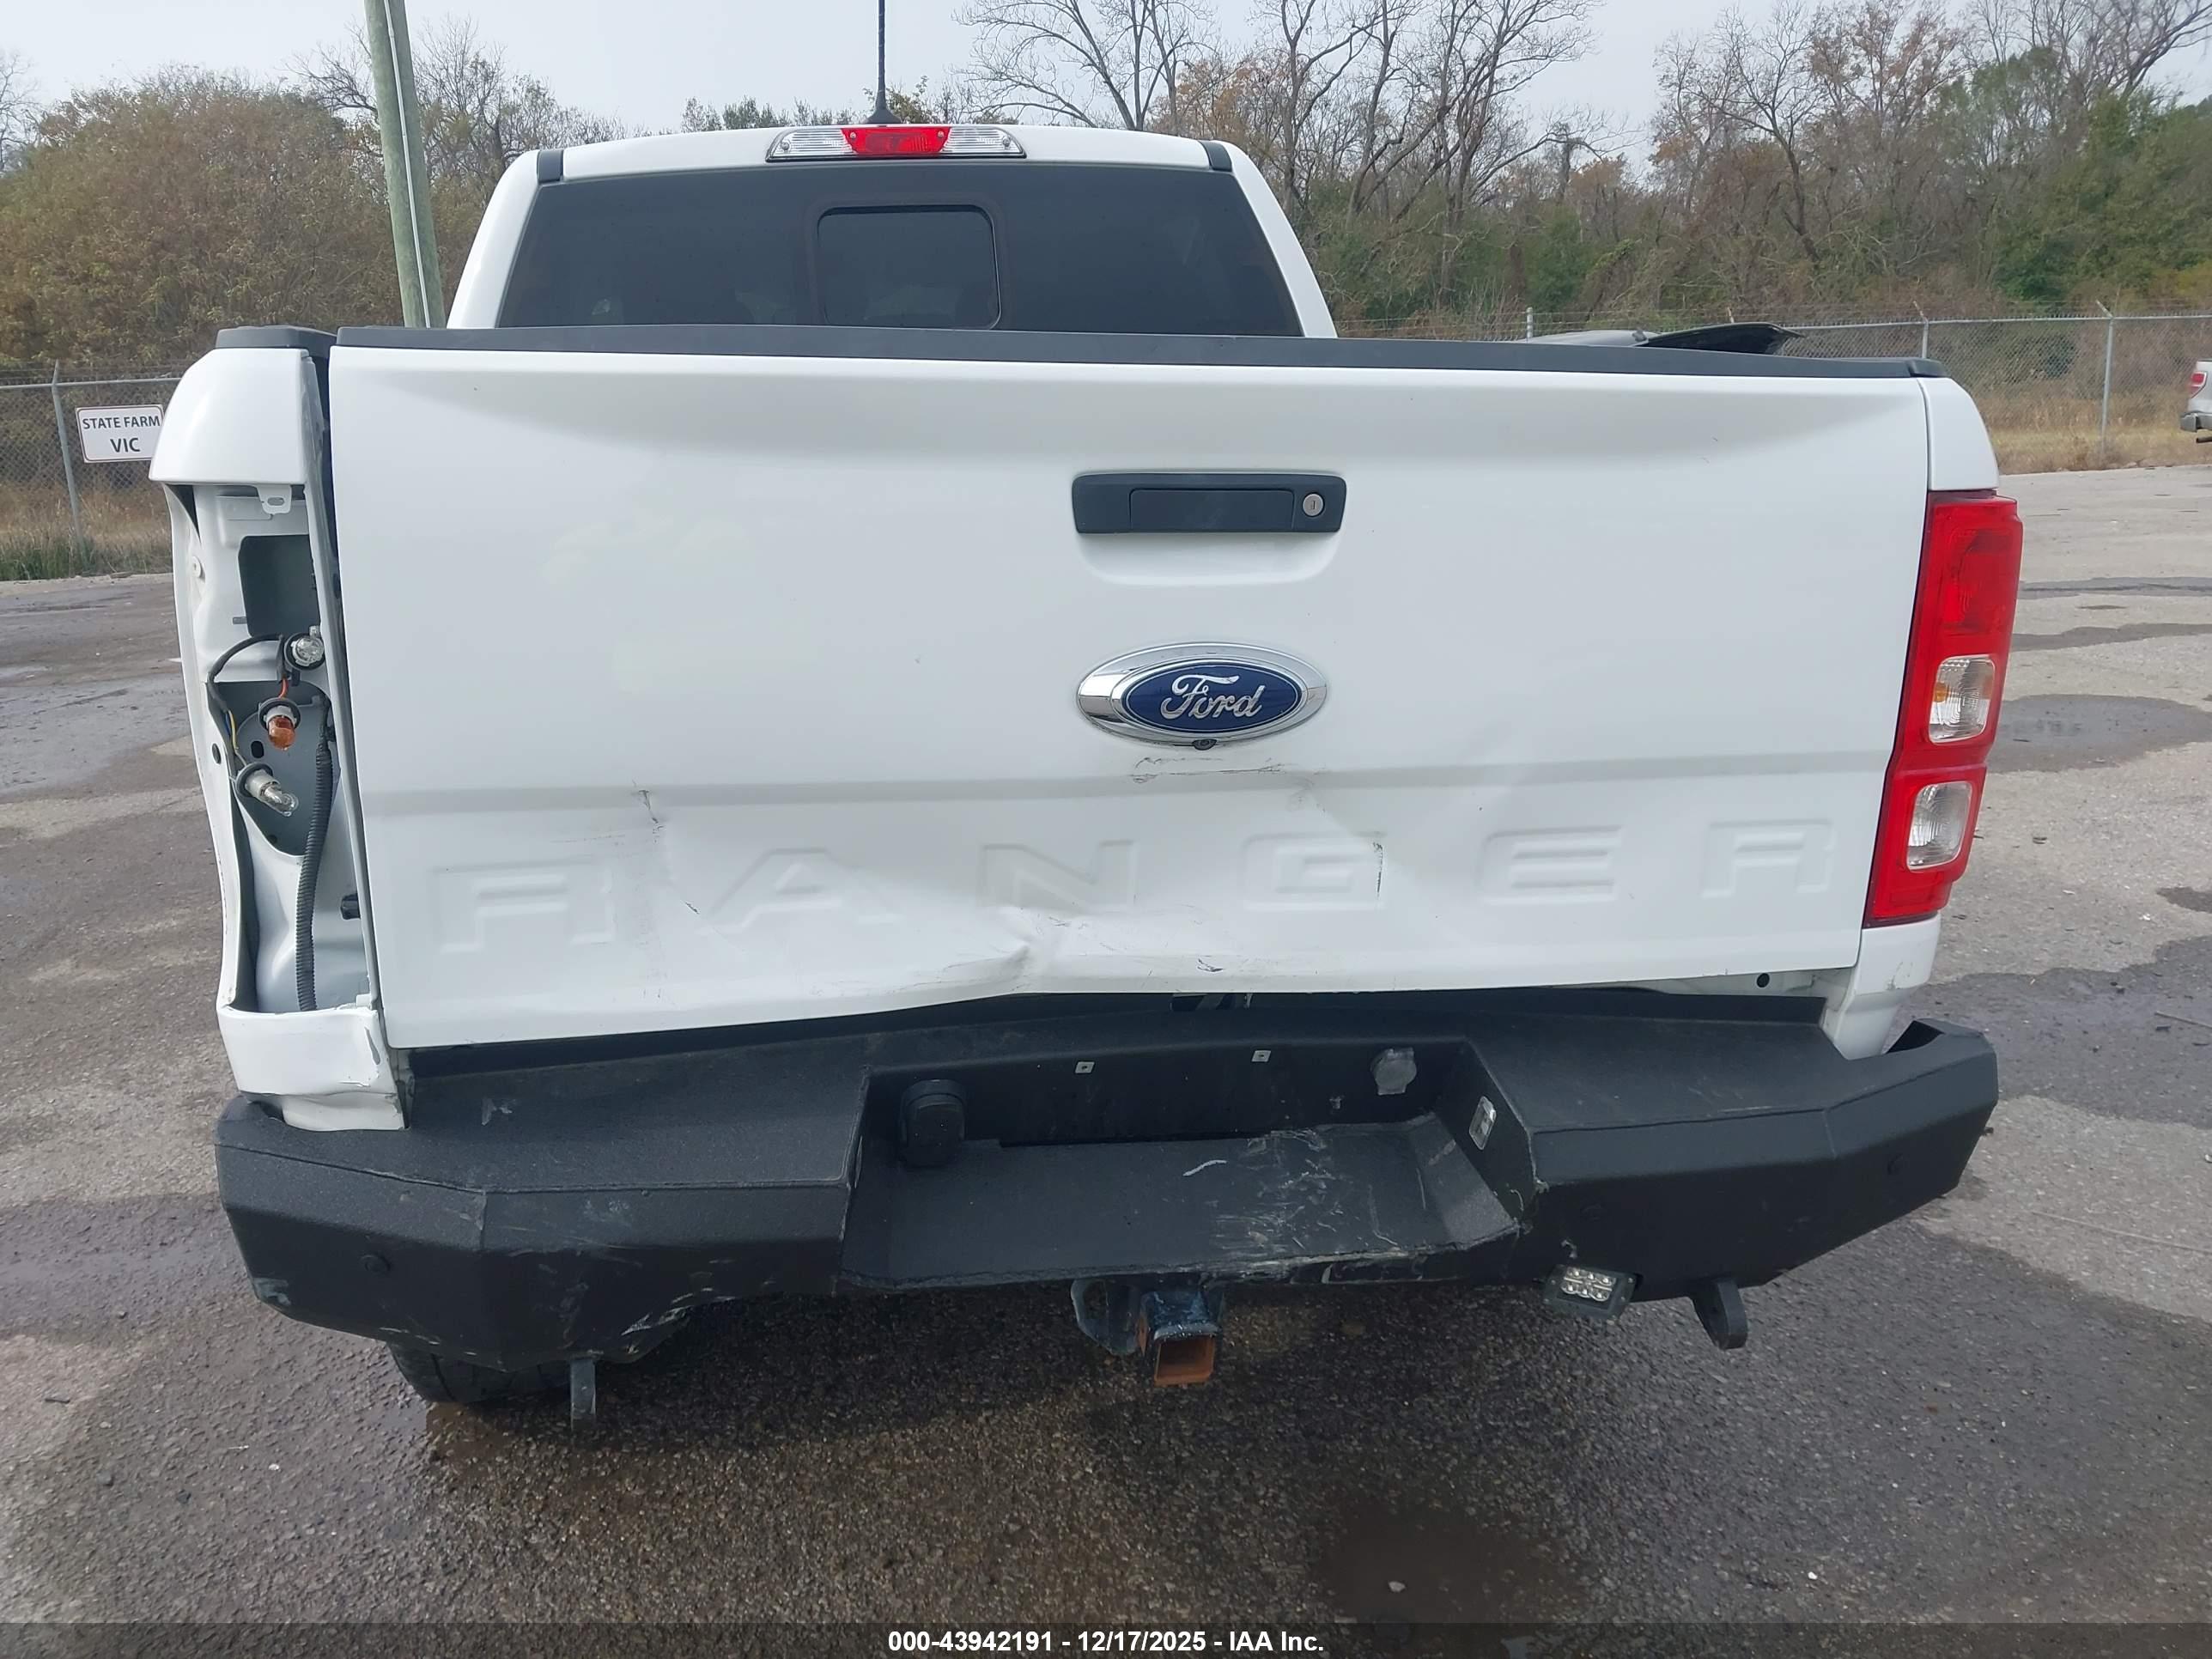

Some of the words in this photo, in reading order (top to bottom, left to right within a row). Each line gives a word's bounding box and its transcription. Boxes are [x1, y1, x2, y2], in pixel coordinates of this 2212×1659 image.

[82, 417, 121, 429] STATE
[124, 416, 161, 428] FARM
[110, 438, 141, 453] VIC
[1160, 674, 1266, 720] Ford
[431, 817, 1836, 954] RANGER
